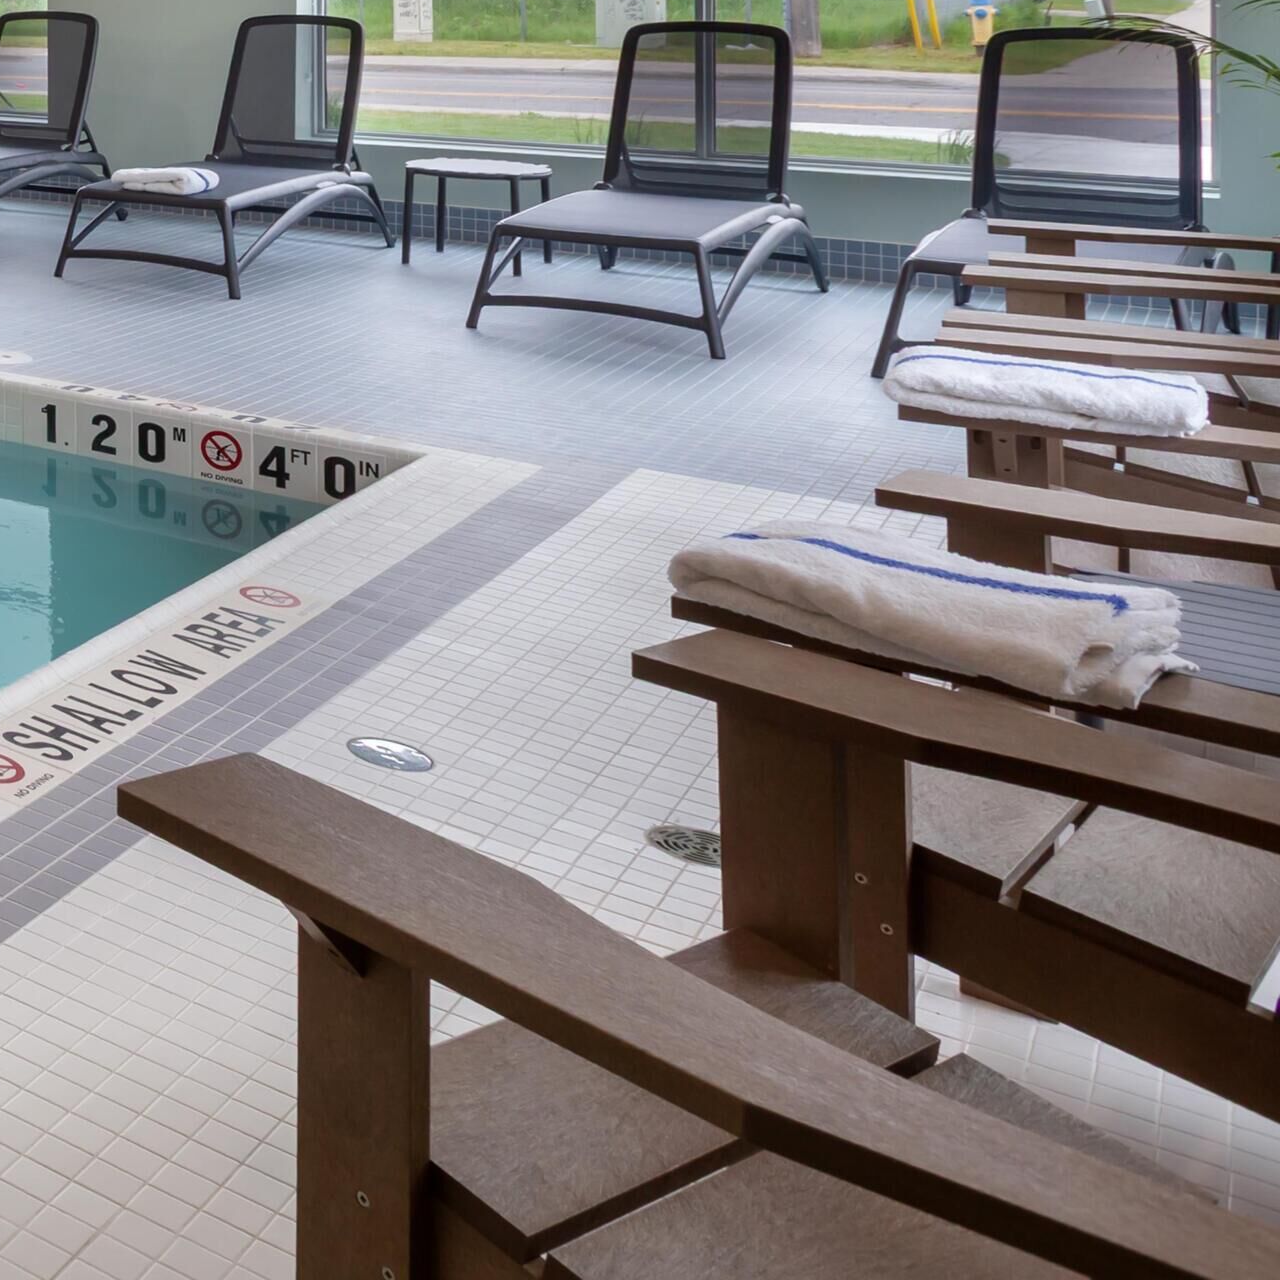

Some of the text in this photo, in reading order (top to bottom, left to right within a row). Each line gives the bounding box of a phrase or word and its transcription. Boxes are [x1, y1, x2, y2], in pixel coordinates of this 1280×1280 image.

[200, 471, 243, 485] NO DIVING
[258, 445, 379, 500] 4 FT 0 IN
[2, 606, 285, 761] SHALLOW AREA
[13, 773, 55, 799] NO DIVING
